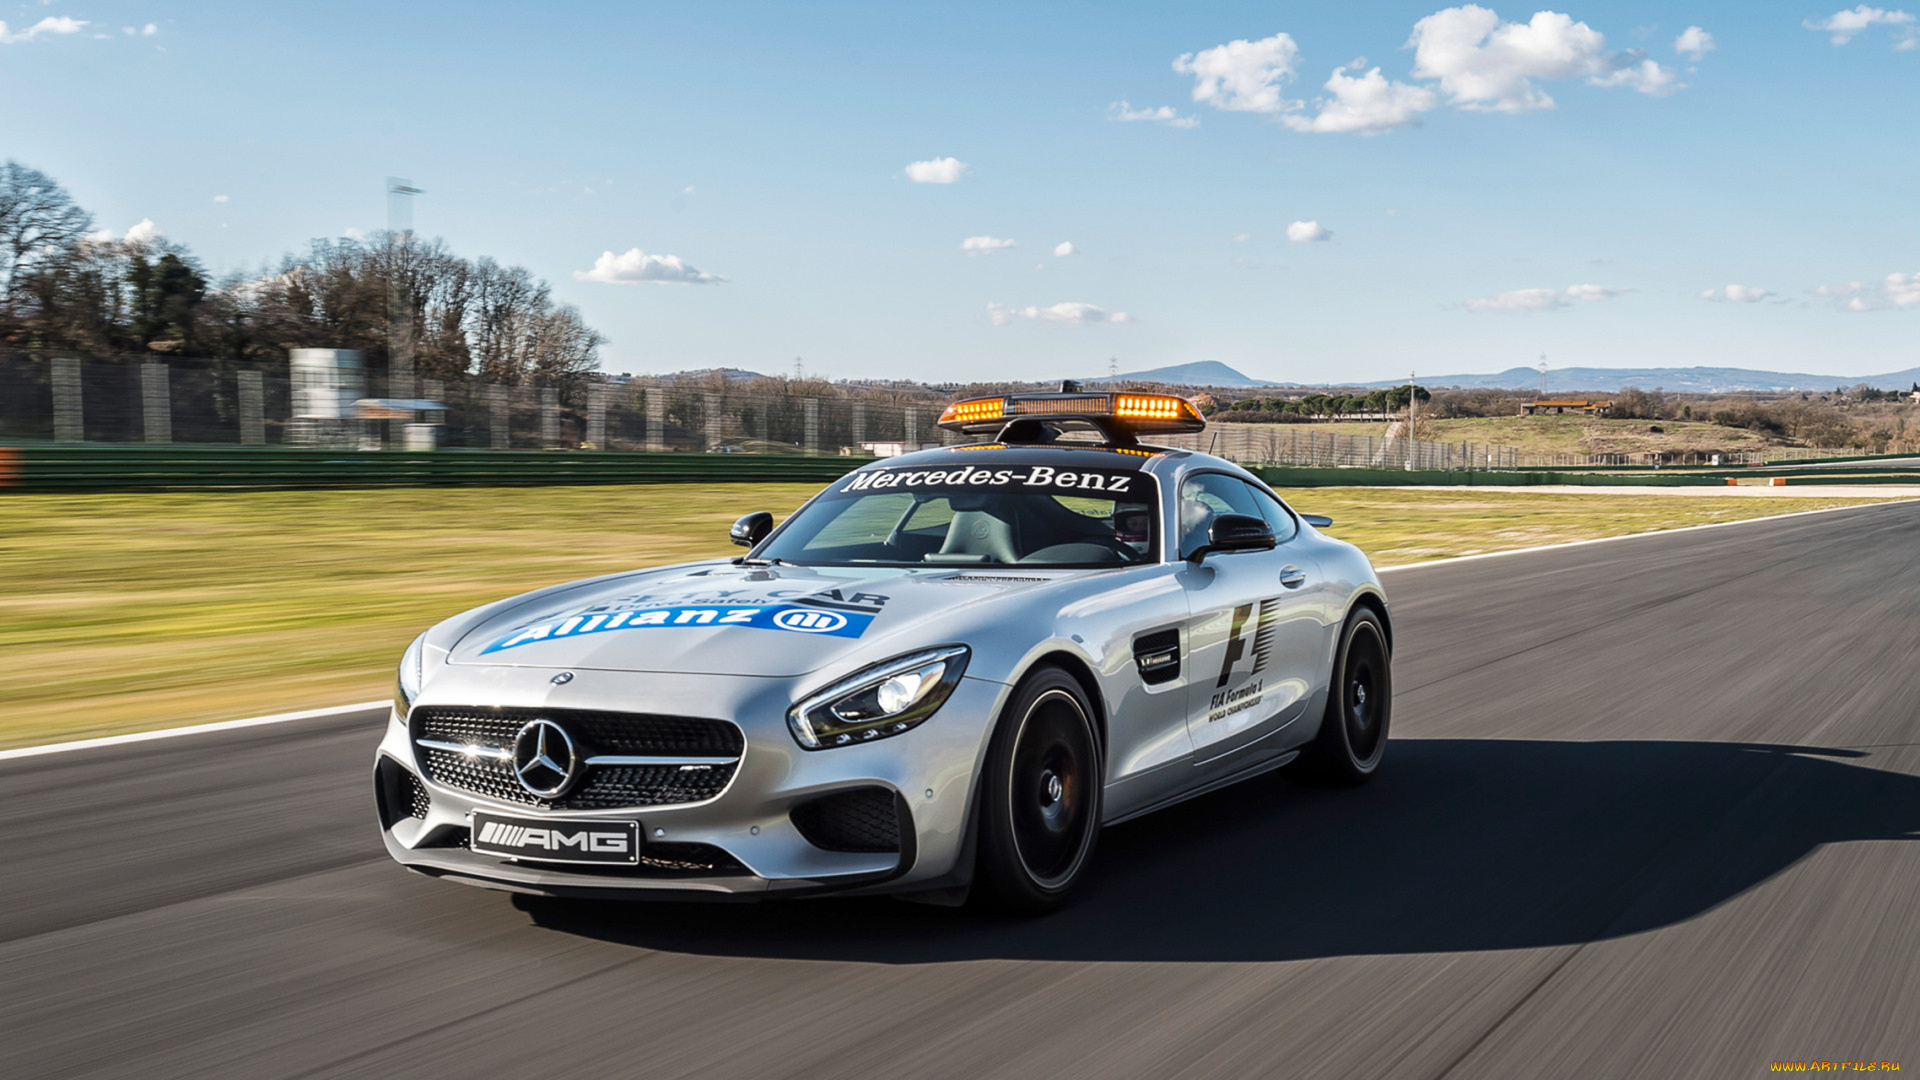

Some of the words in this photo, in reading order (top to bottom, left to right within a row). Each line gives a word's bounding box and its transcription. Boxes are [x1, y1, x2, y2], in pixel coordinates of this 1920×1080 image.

[840, 466, 1131, 493] Mercedes-Benz
[615, 601, 682, 611] Drive
[501, 608, 760, 647] Allianz
[1210, 694, 1225, 710] FIA
[1226, 684, 1257, 704] Formula
[1257, 679, 1263, 692] 1
